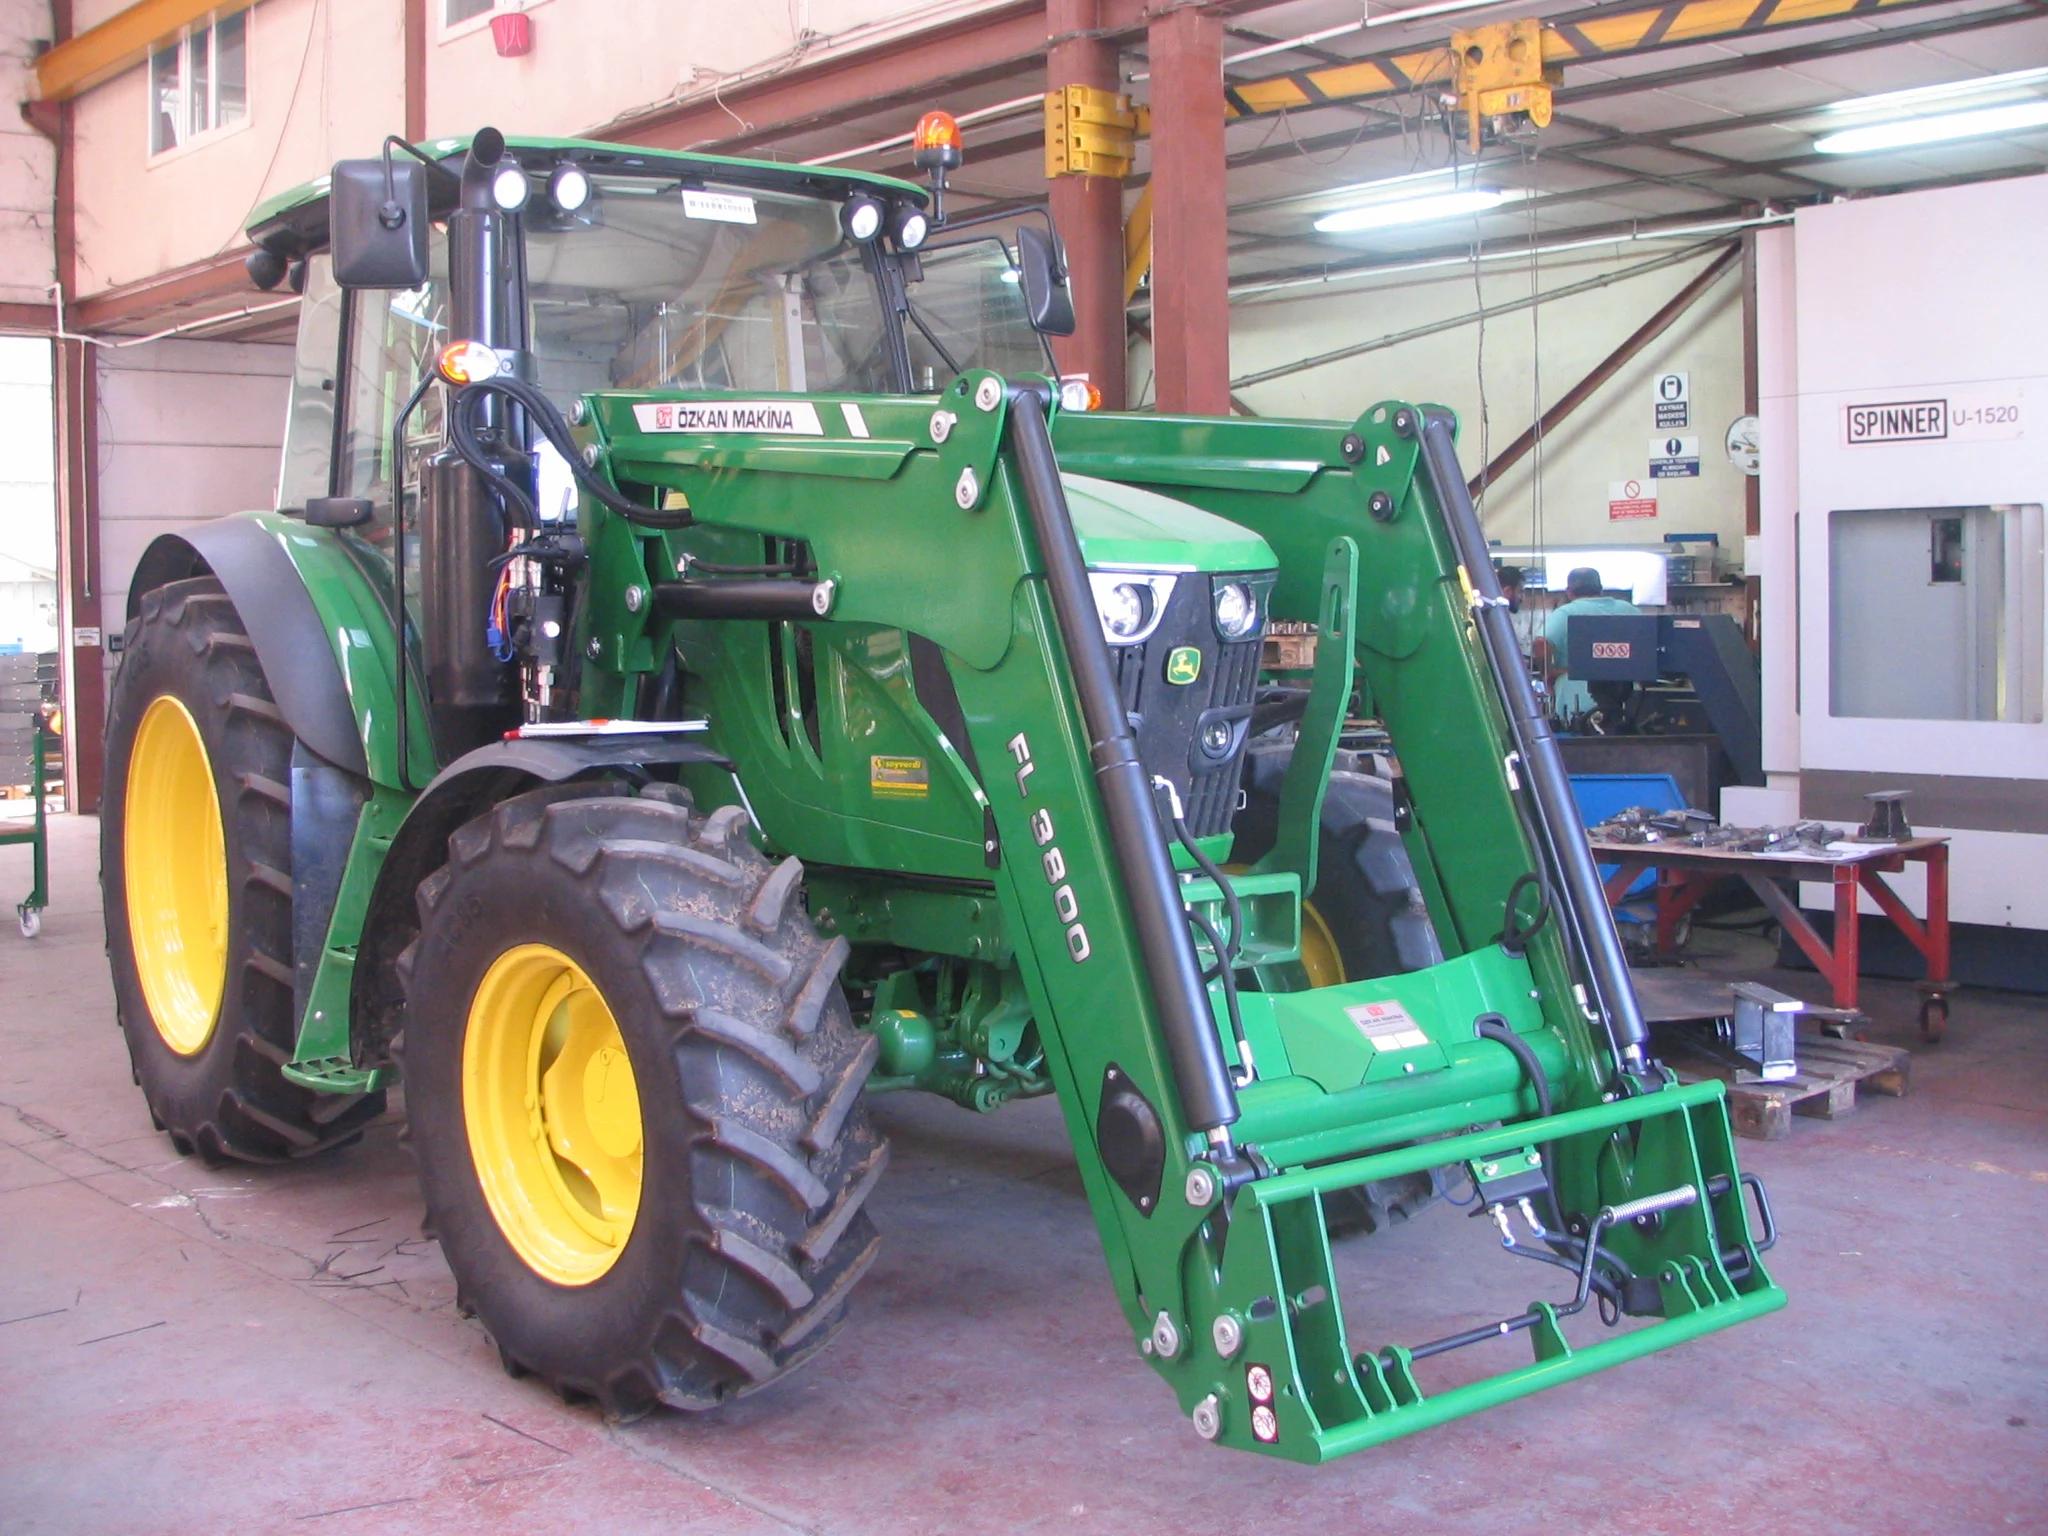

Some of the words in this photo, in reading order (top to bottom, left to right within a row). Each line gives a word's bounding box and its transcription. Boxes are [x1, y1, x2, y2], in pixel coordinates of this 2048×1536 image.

[678, 406, 728, 429] ÖZKAN
[732, 406, 793, 429] MAKİNA
[1853, 406, 1940, 437] SPINNER
[1952, 405, 2019, 427] U-1520
[1006, 731, 1036, 799] FL
[1029, 807, 1092, 964] 3800
